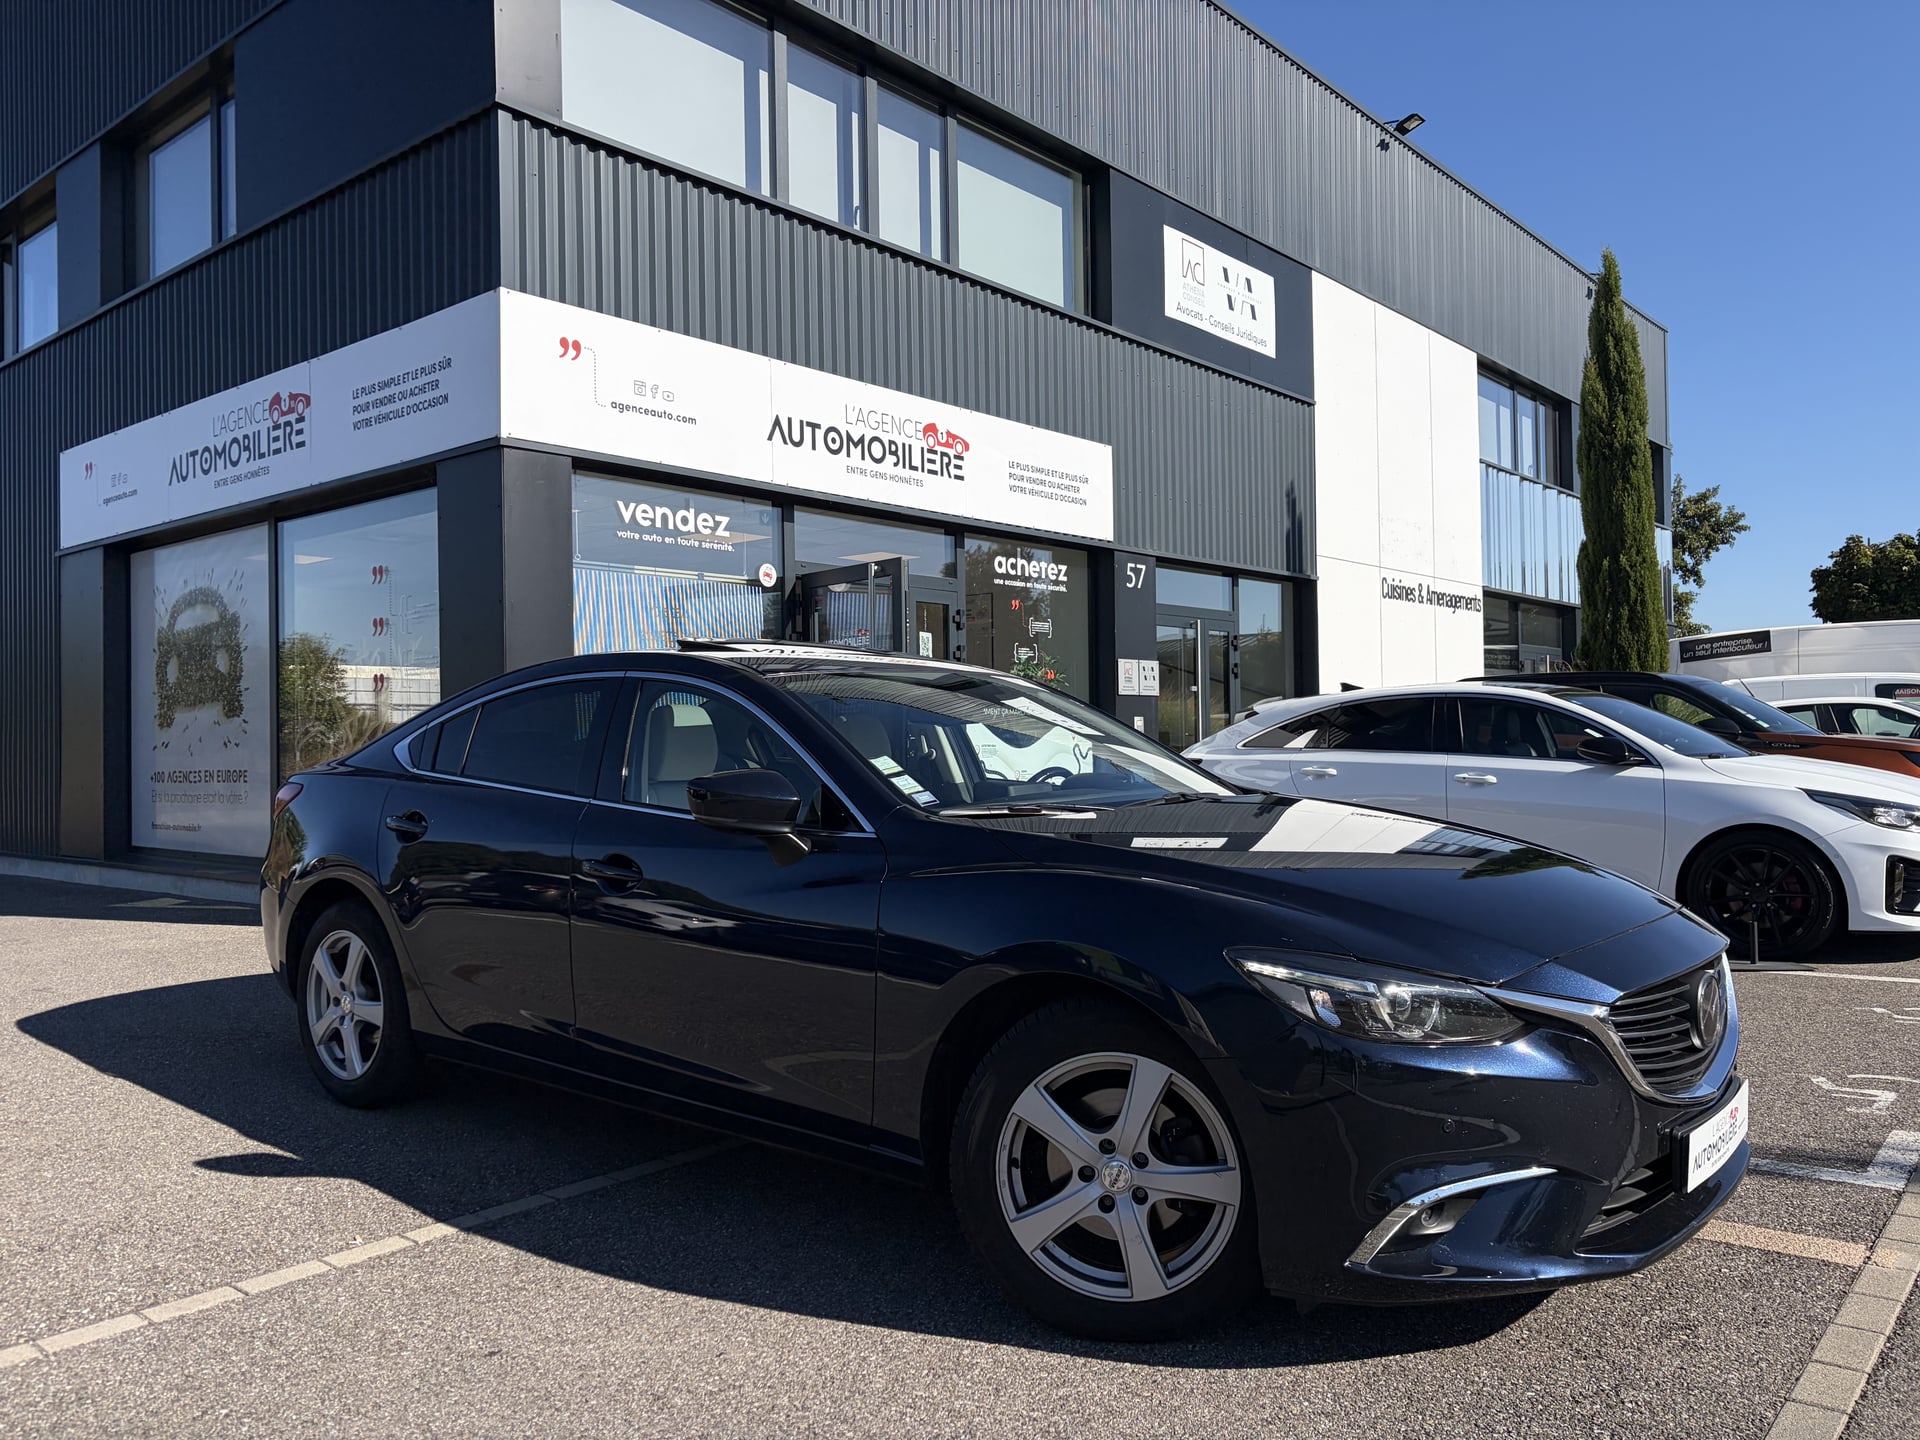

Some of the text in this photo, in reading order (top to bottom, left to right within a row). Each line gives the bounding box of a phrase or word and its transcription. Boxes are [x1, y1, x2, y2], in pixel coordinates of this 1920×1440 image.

[1176, 300, 1204, 322] Avocats
[1208, 314, 1235, 334] Conseils
[1236, 326, 1268, 348] Juridiques
[352, 356, 452, 400] LE PLUS SIMPLE ET LE PLUS SÛR
[352, 378, 440, 416] POUR VENDRE OU ACHETER
[213, 398, 269, 437] L'AGENCE
[352, 393, 449, 431] VOTRE VÉHICULE D'OCCASION
[610, 401, 697, 426] agenceauto.com
[845, 404, 923, 441] L'AGENCE
[214, 476, 229, 489] ENTRE
[230, 472, 243, 485] GENS
[846, 465, 924, 488] ENTRE GENS HONNÊTES
[1008, 460, 1015, 469] LE
[1016, 462, 1030, 472] PLUS
[1030, 466, 1050, 476] SIMPLE
[1051, 470, 1058, 478] ET
[1058, 472, 1064, 480] LE
[1065, 472, 1078, 482] PLUS
[1008, 472, 1080, 494] POUR VENDRE OU ACHETER
[1008, 484, 1087, 506] VOTRE VÉHICULE D'OCCASION
[616, 500, 731, 538] vendez
[616, 530, 736, 552] votre auto en toute sérénité.
[994, 556, 1068, 582] achetez
[1126, 562, 1146, 588] 57
[1004, 579, 1026, 588] occasion
[1034, 582, 1046, 590] toute
[1382, 577, 1416, 603] Cuisines
[1418, 583, 1424, 604] &
[1695, 643, 1711, 651] une
[1696, 648, 1712, 656] seul
[1712, 642, 1763, 654] interlocuteur
[150, 770, 248, 784] +100 AGENCES EN EUROPE
